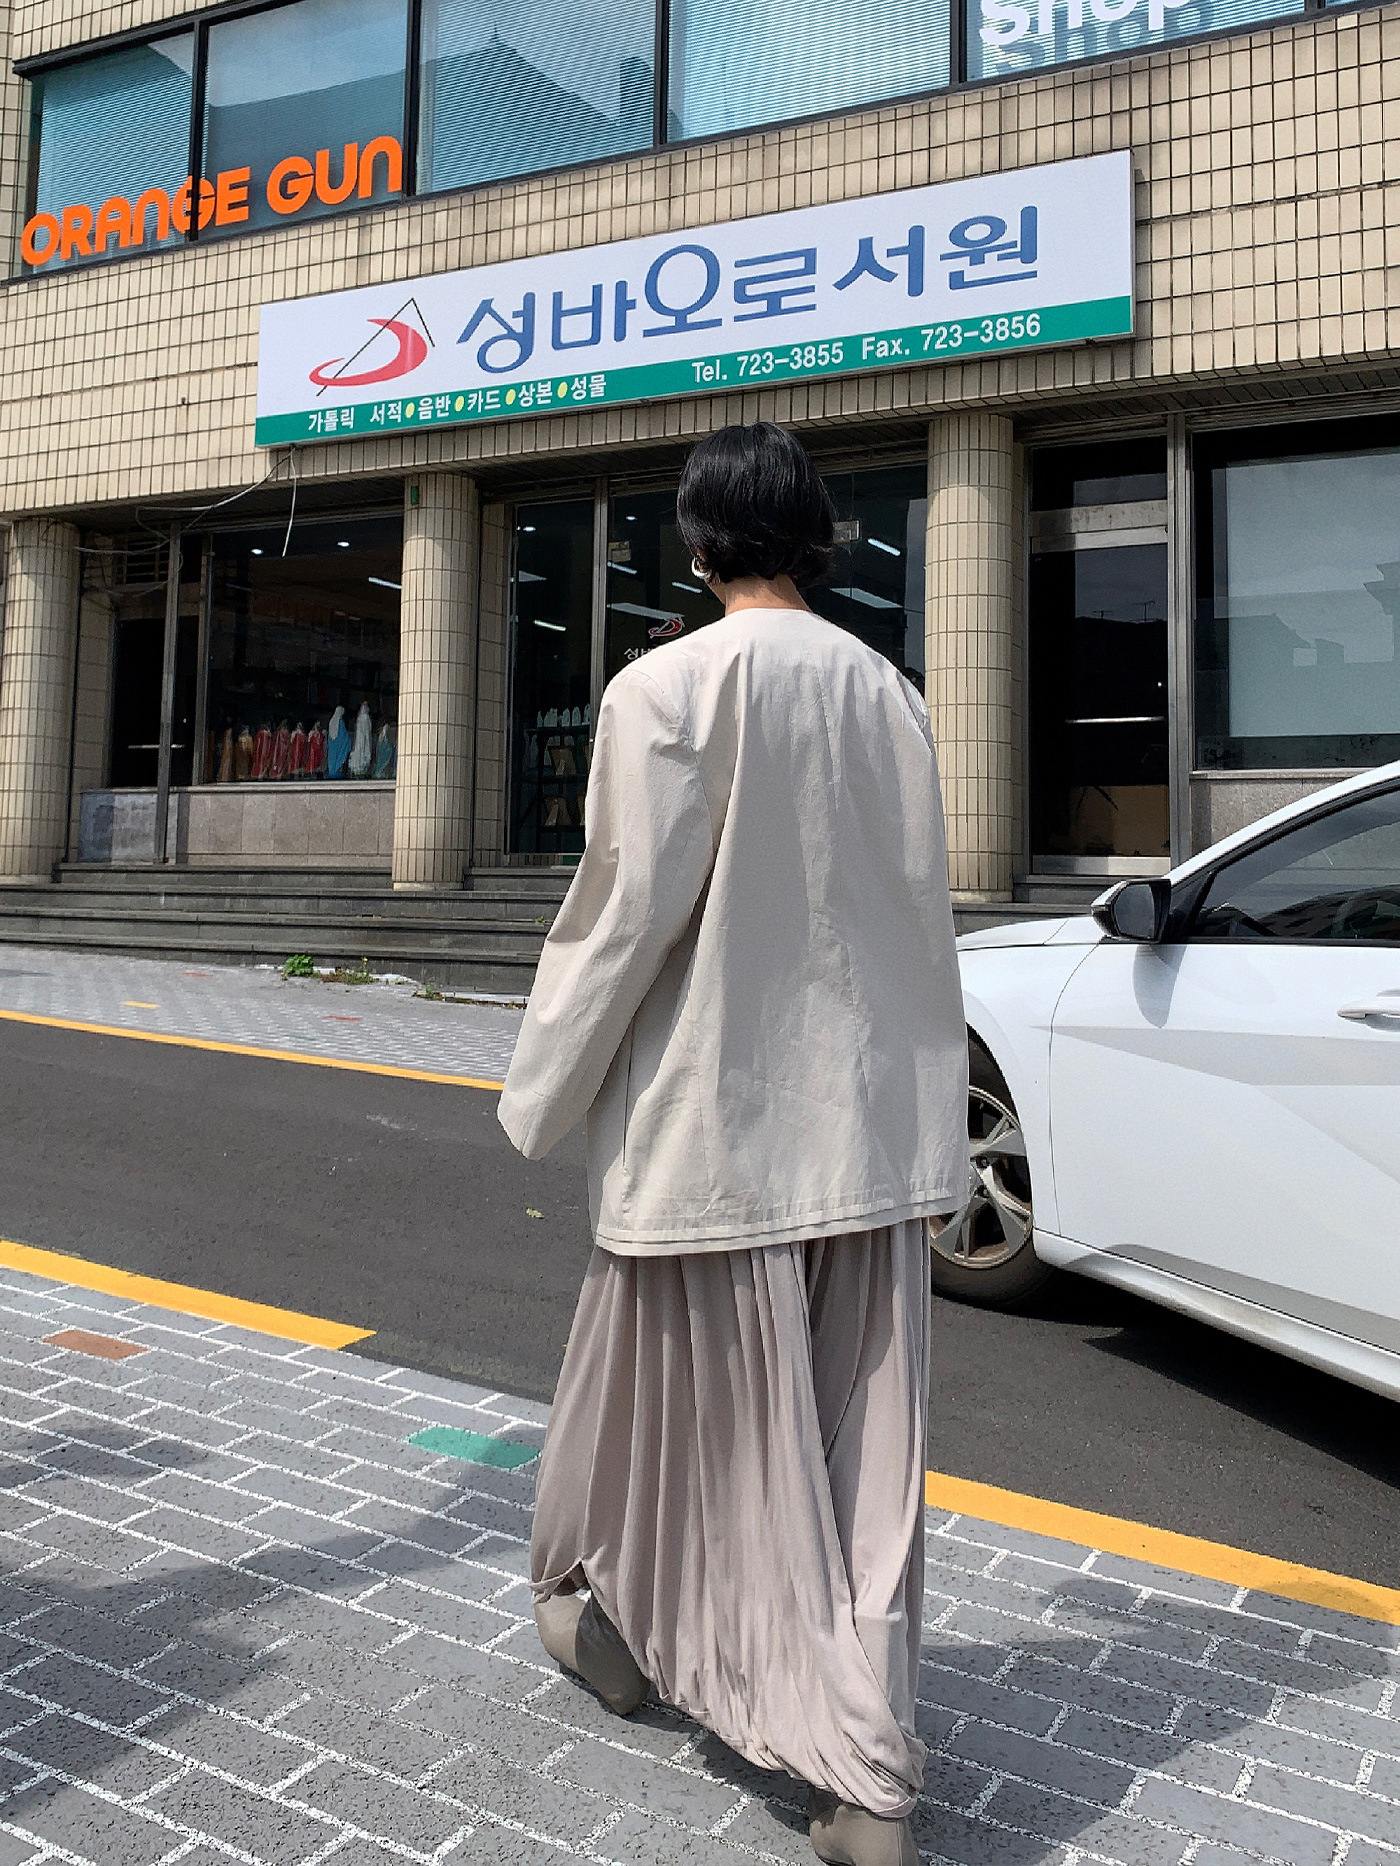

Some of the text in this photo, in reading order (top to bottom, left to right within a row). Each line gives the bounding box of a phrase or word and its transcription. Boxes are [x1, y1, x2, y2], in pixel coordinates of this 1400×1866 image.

[21, 137, 403, 265] ORANGE GUN
[458, 206, 1038, 374] 성바오로서원
[691, 312, 1041, 383] Tel. 723-3855 Fax. 723-3856
[308, 406, 355, 433] 가톨릭
